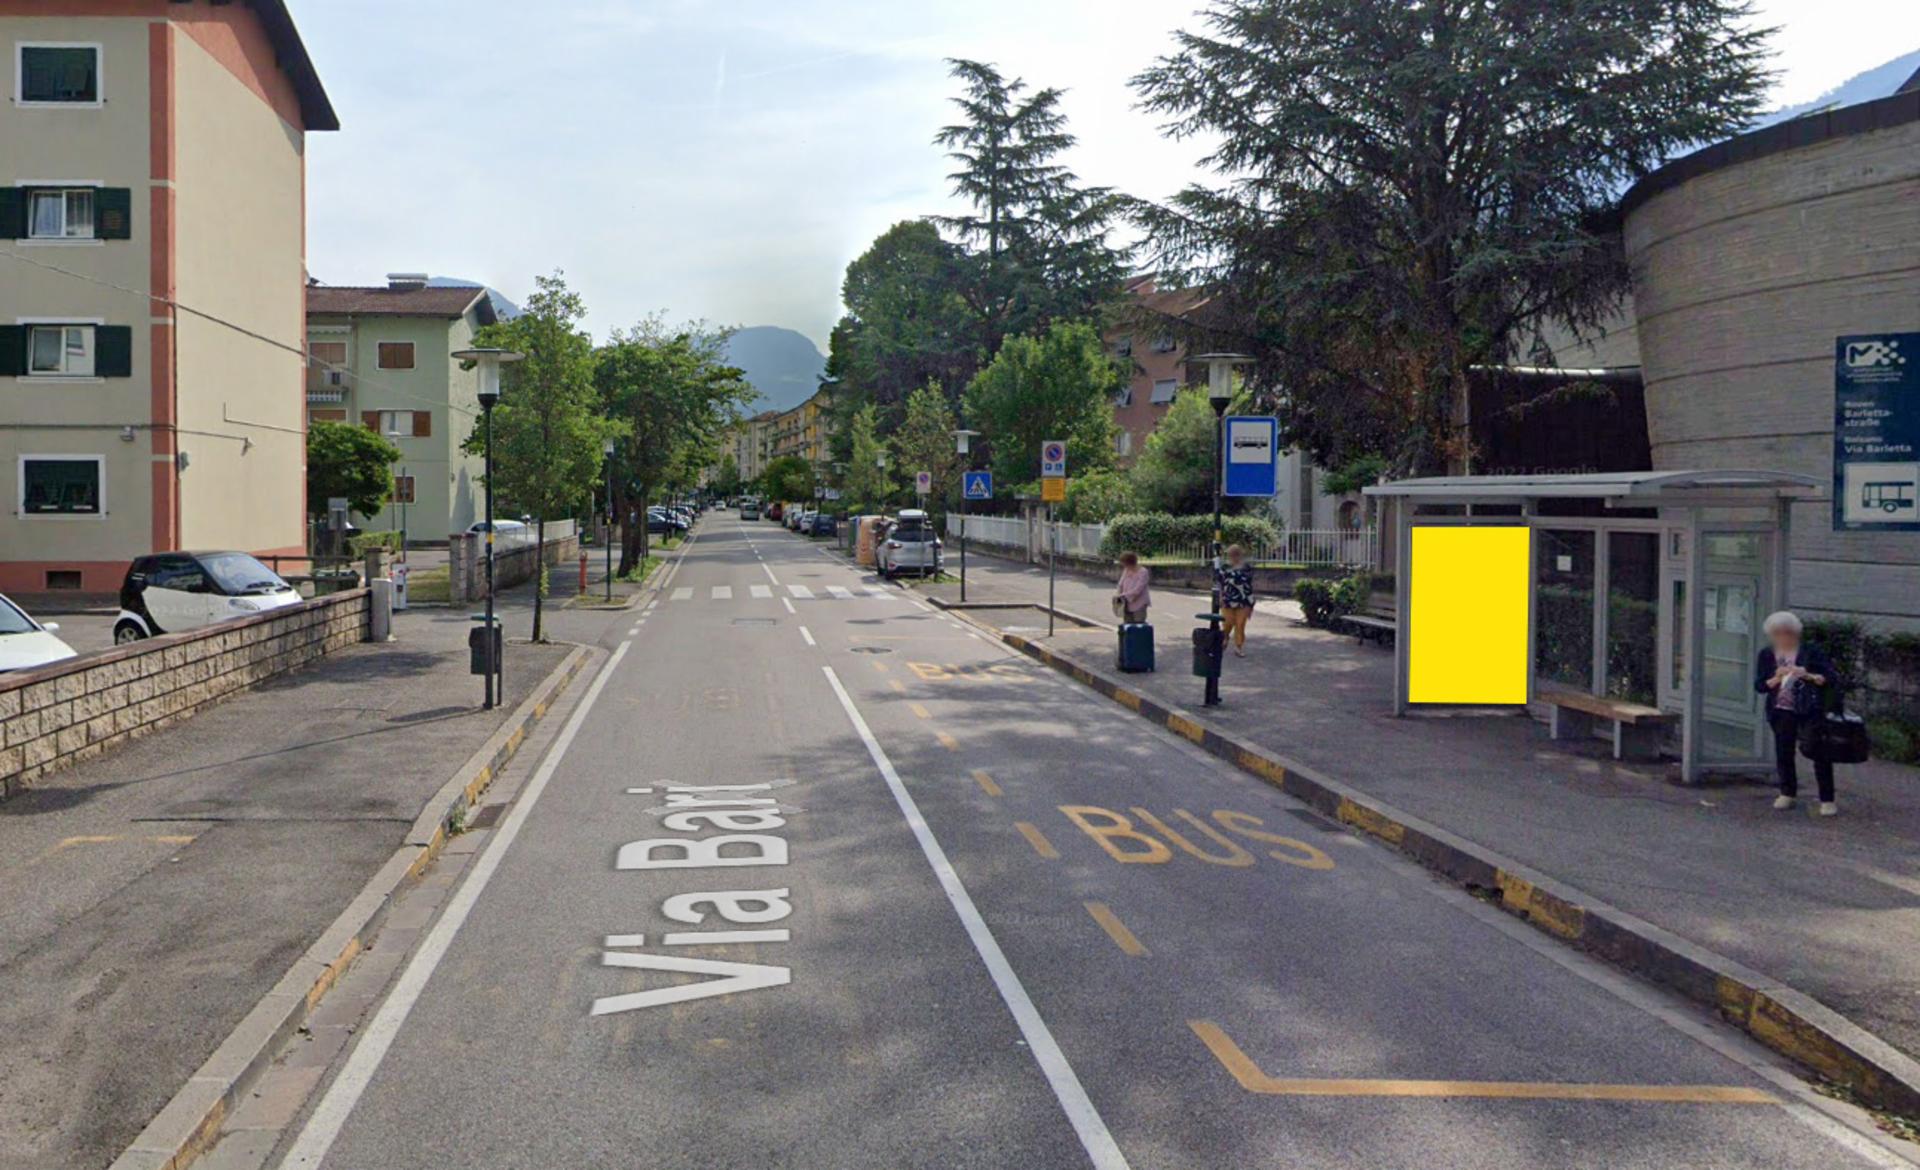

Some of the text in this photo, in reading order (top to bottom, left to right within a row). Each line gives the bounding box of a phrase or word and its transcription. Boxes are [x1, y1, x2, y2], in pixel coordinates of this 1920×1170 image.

[1844, 444, 1912, 453] Via Barletta
[1058, 805, 1336, 870] BUS
